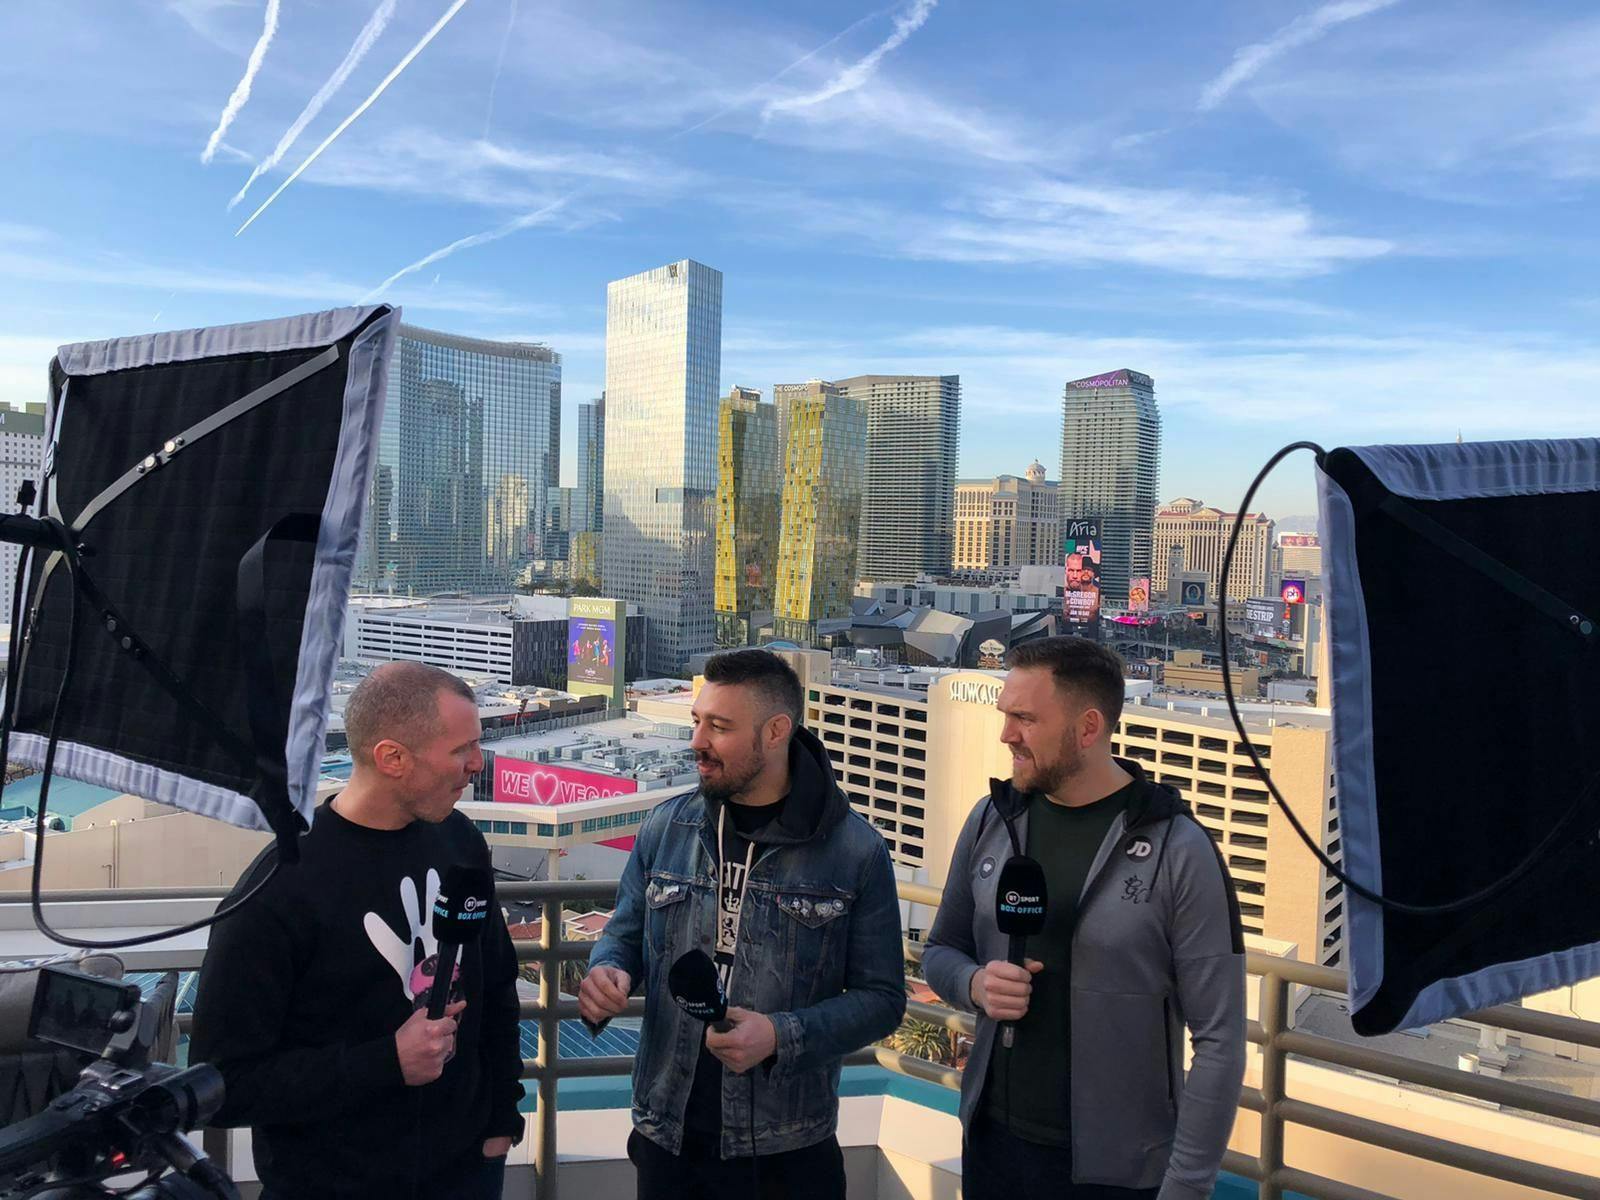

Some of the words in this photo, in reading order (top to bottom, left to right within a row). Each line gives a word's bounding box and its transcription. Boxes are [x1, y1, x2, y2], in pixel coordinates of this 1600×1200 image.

[1076, 379, 1128, 389] COSMOPOLITAN
[1069, 521, 1097, 537] Aria
[573, 603, 591, 613] PARK
[593, 606, 610, 615] MGM
[502, 770, 531, 797] WE
[560, 780, 625, 804] VEG
[1127, 841, 1152, 857] JD
[1001, 904, 1016, 912] BOX
[1017, 906, 1043, 914] OFFICE
[457, 912, 472, 920] BOX
